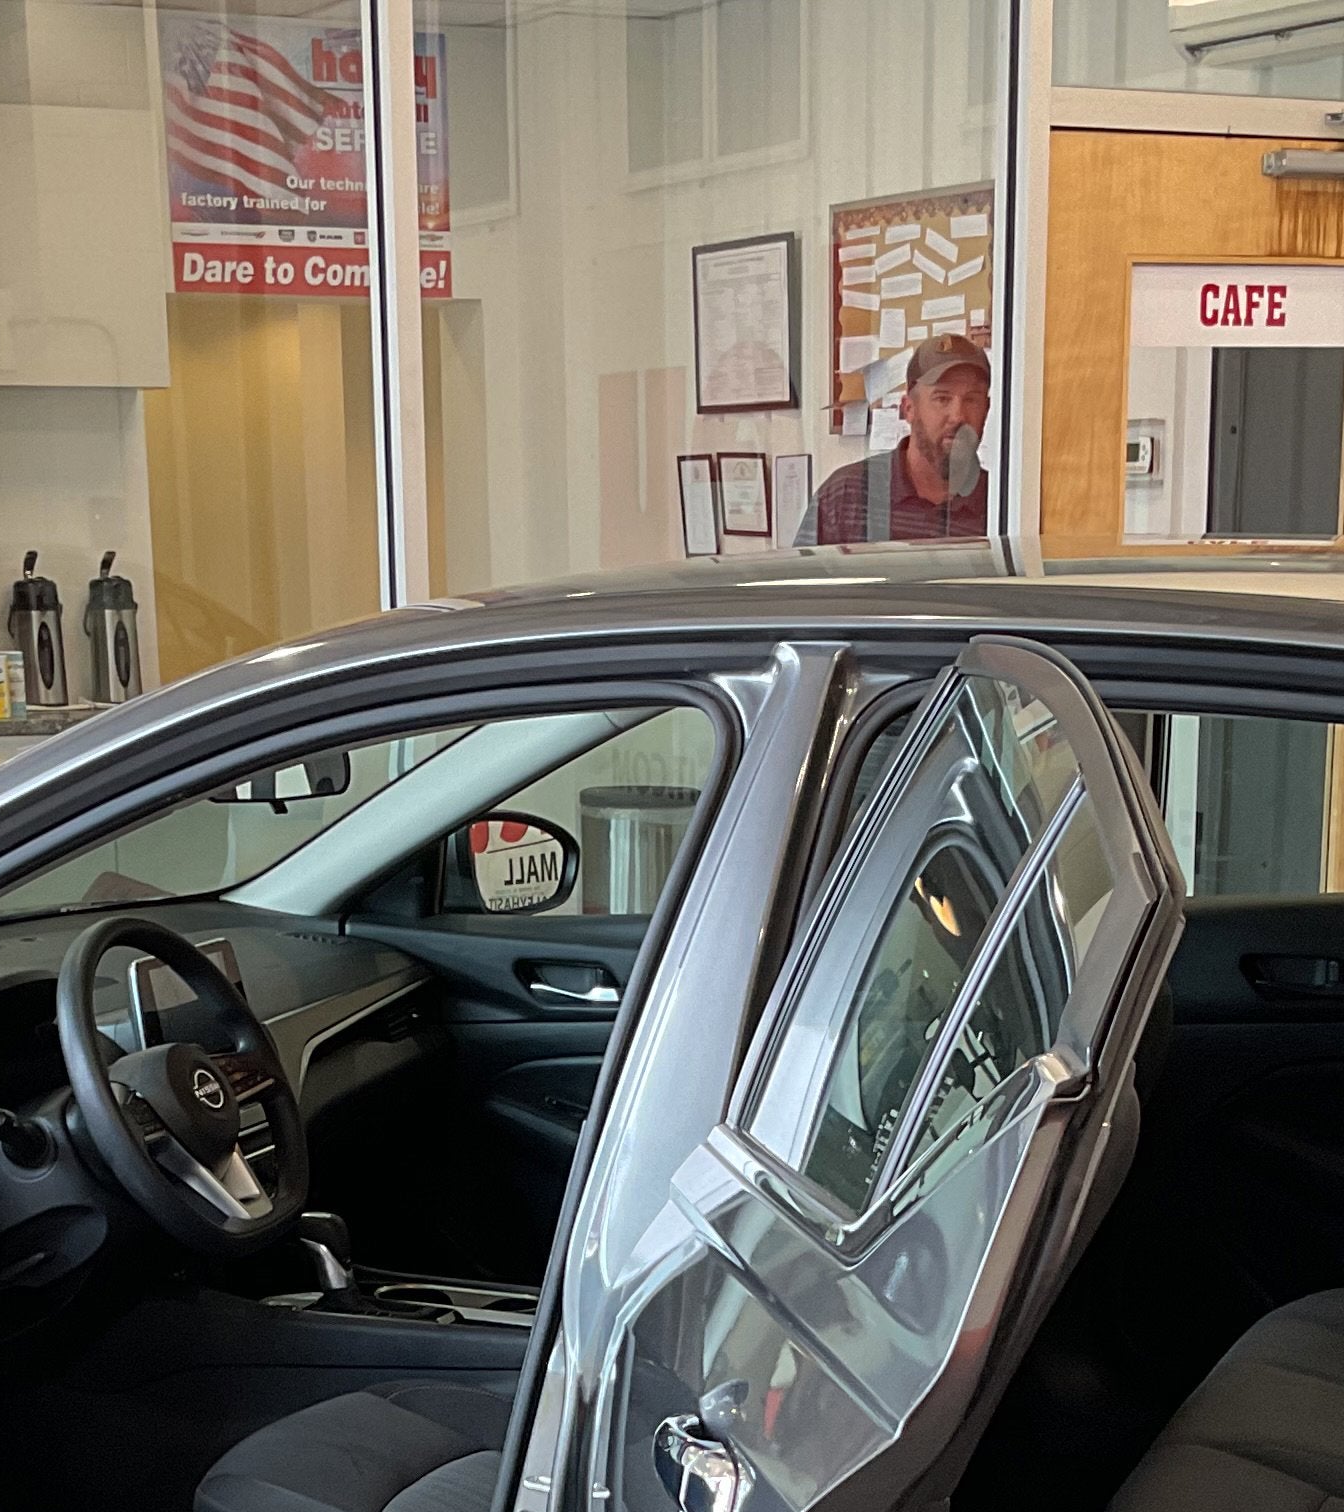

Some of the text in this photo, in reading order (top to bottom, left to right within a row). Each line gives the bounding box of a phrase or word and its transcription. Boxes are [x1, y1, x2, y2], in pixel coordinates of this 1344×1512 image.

[286, 175, 315, 190] Our
[181, 192, 327, 211] factory trained for
[182, 251, 254, 283] Dare
[264, 256, 294, 285] to
[1200, 283, 1287, 327] CAFE
